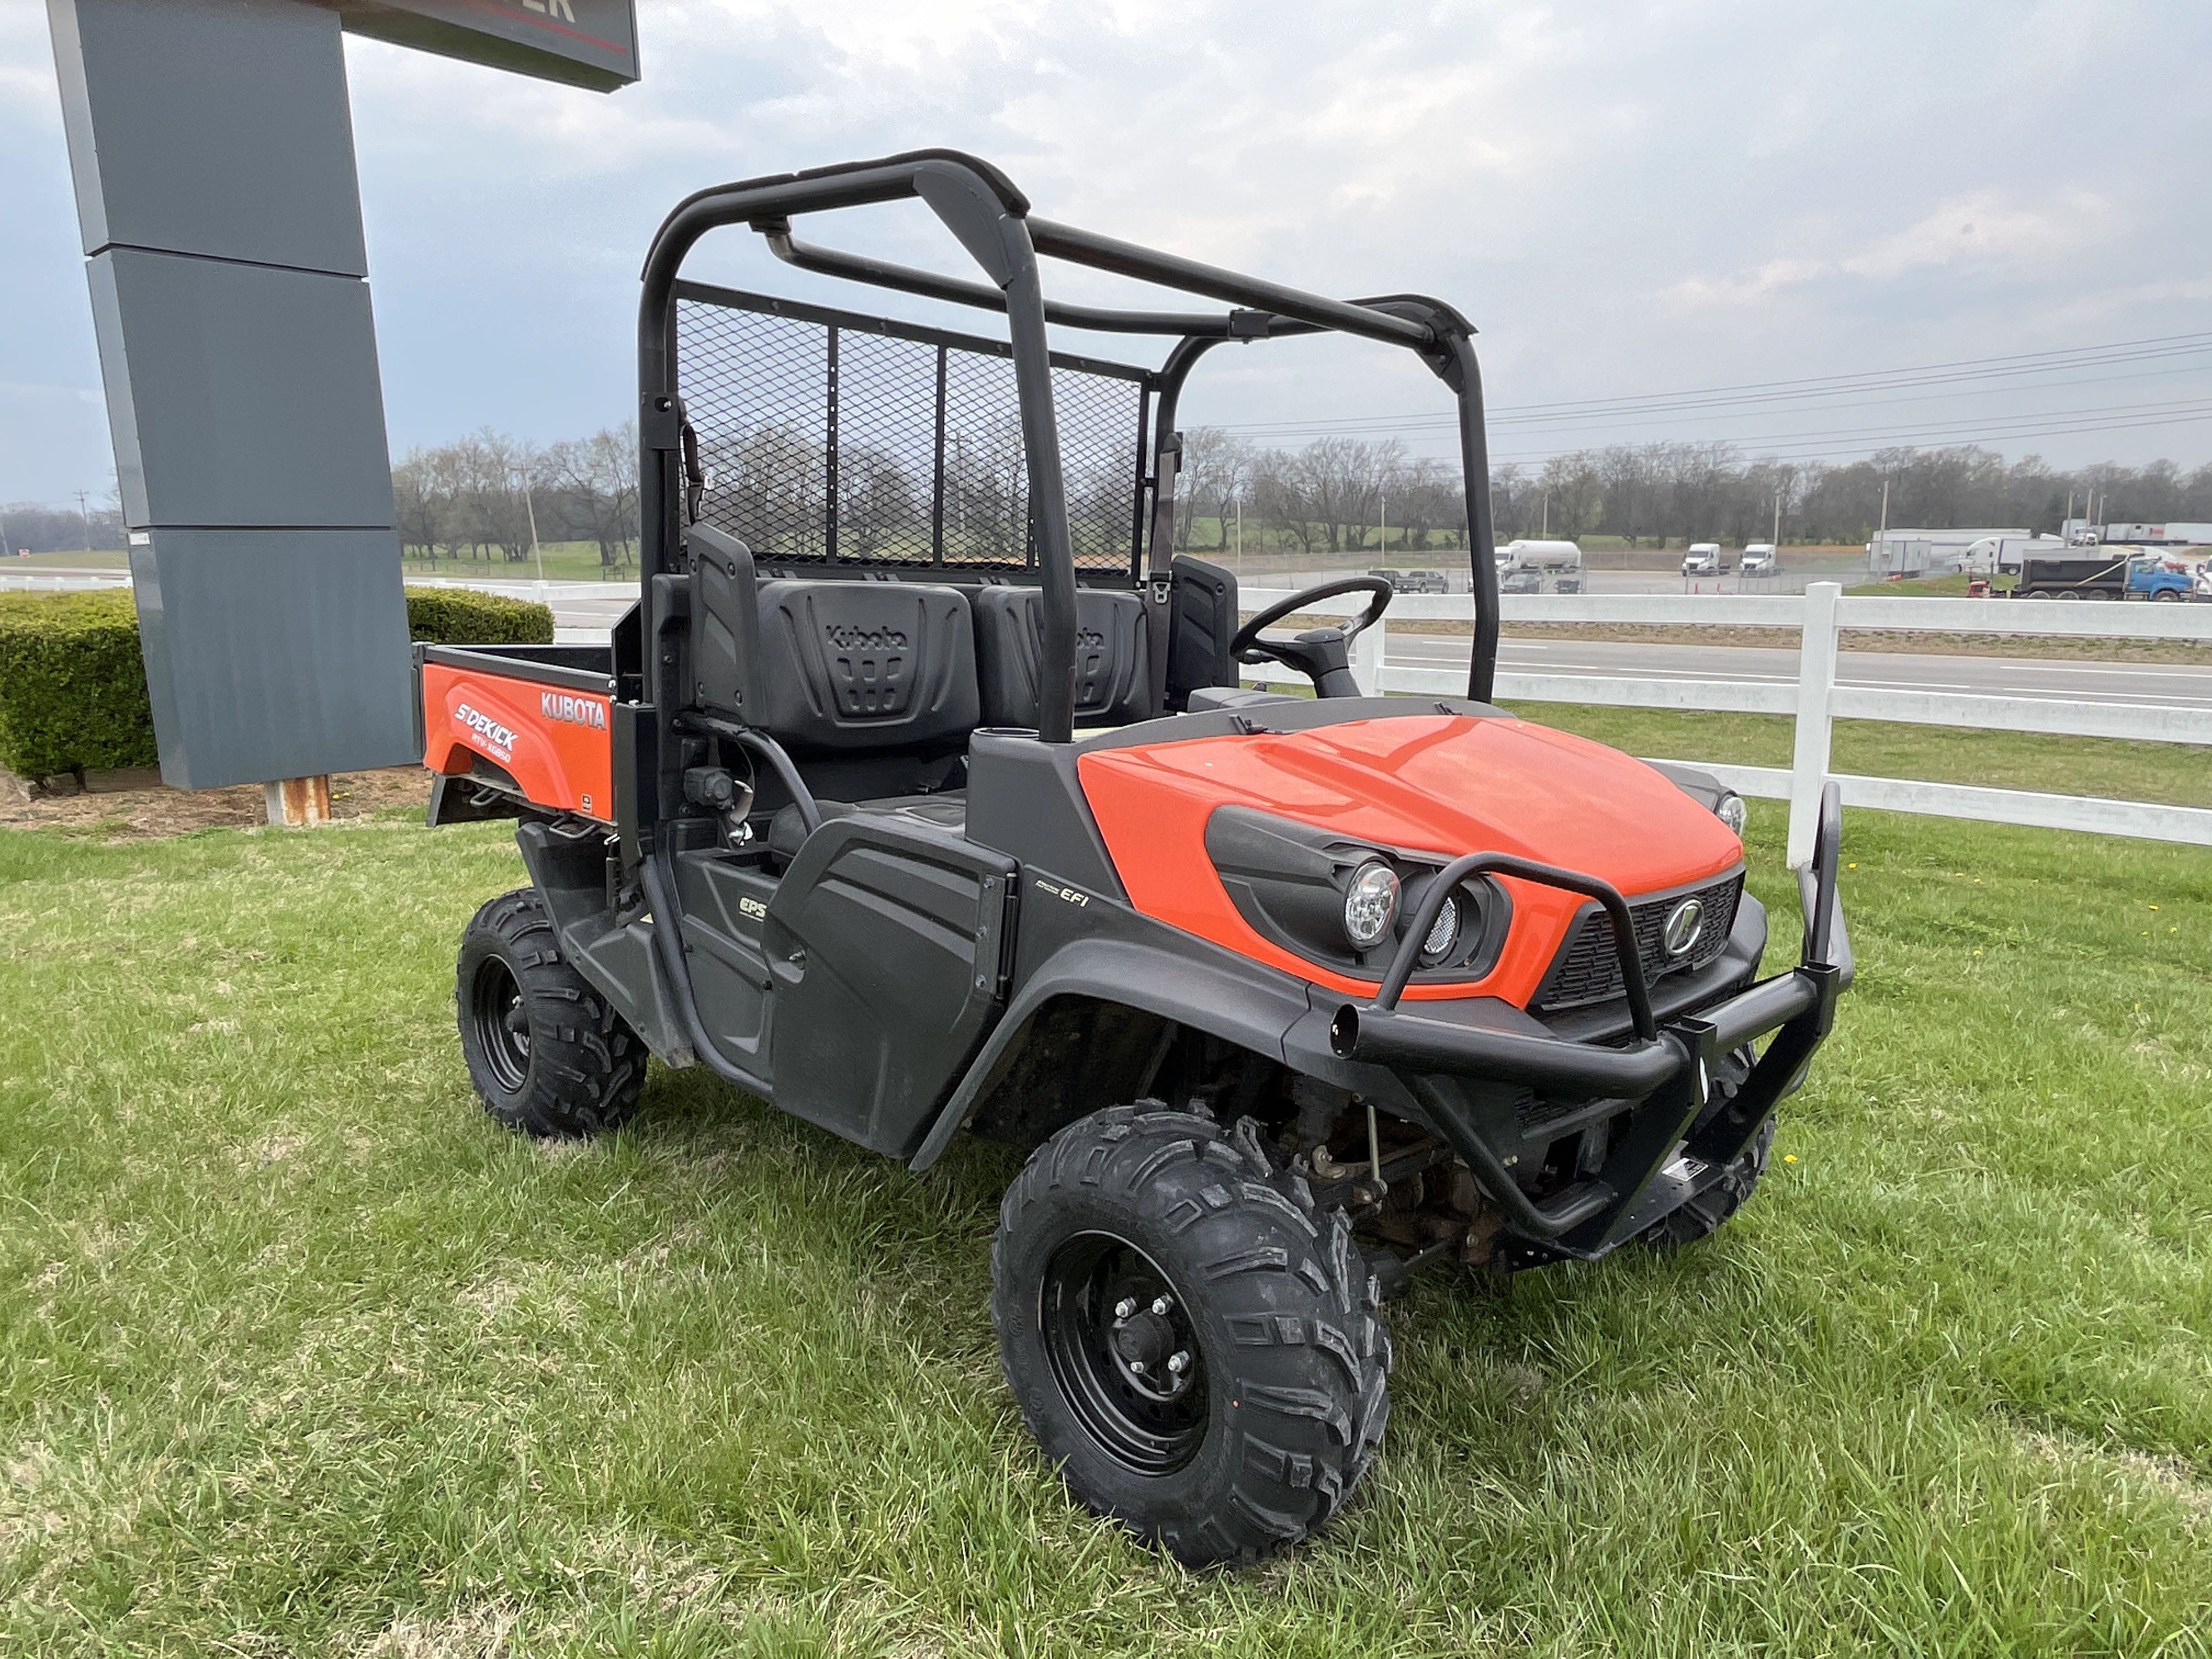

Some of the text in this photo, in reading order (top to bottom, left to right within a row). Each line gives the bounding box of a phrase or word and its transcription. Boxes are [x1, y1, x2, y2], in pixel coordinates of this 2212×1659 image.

[826, 625, 908, 651] Kubota
[540, 692, 605, 729] KUBOTA
[454, 703, 518, 752] SIDEKICK
[740, 898, 767, 917] EPS
[1060, 888, 1089, 907] EFI
